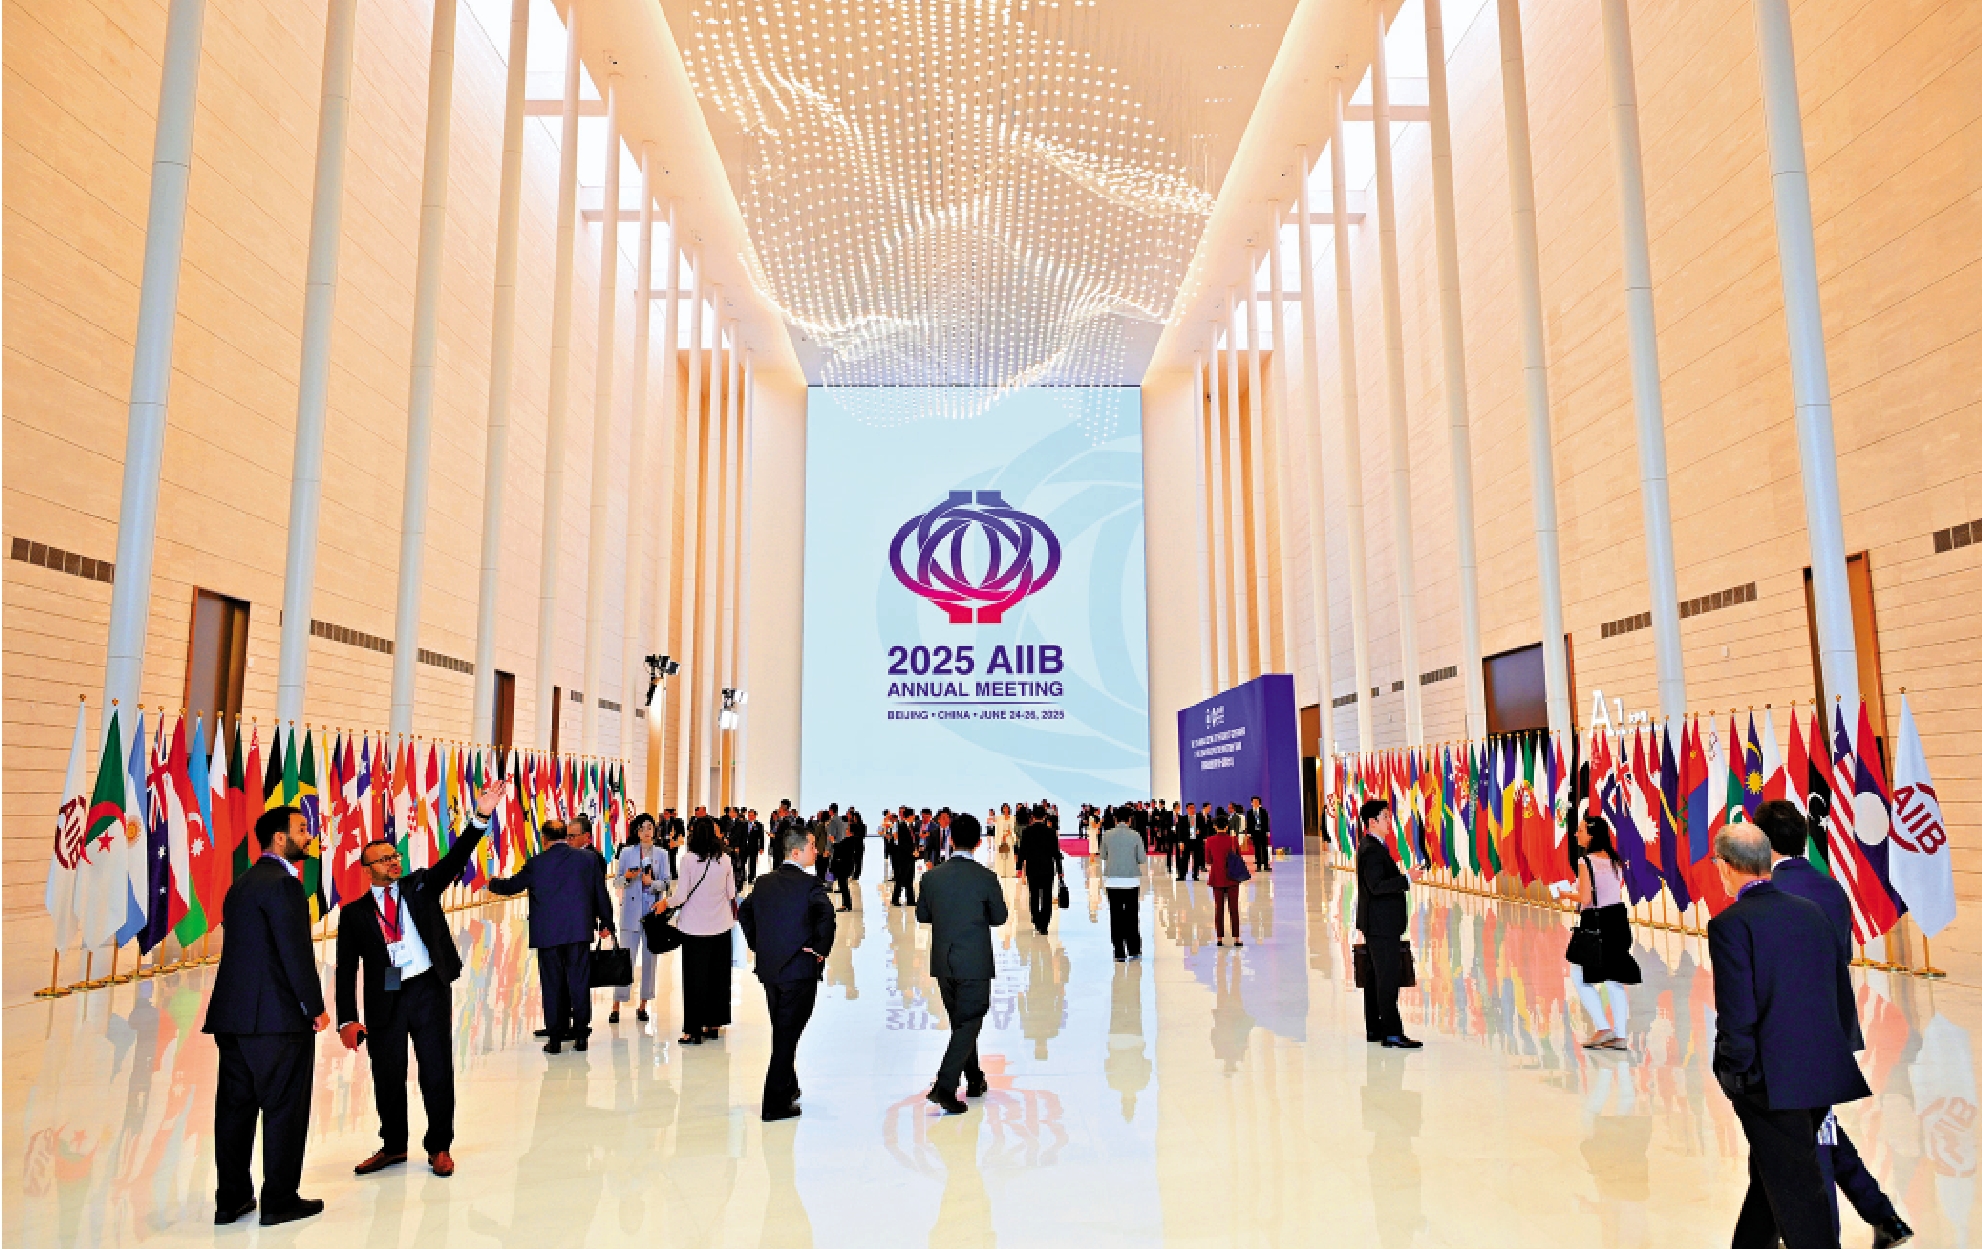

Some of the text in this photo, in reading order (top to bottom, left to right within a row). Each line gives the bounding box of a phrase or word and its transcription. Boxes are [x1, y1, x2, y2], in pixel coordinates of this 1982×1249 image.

[887, 644, 1065, 676] 2025 AIIB
[887, 680, 1065, 698] ANNUAL MEETING
[887, 710, 929, 720] BEIJING
[937, 710, 971, 720] CHINA
[979, 710, 1007, 720] JUNE
[1041, 710, 1065, 720] 2025
[1893, 785, 1947, 855] AIIB
